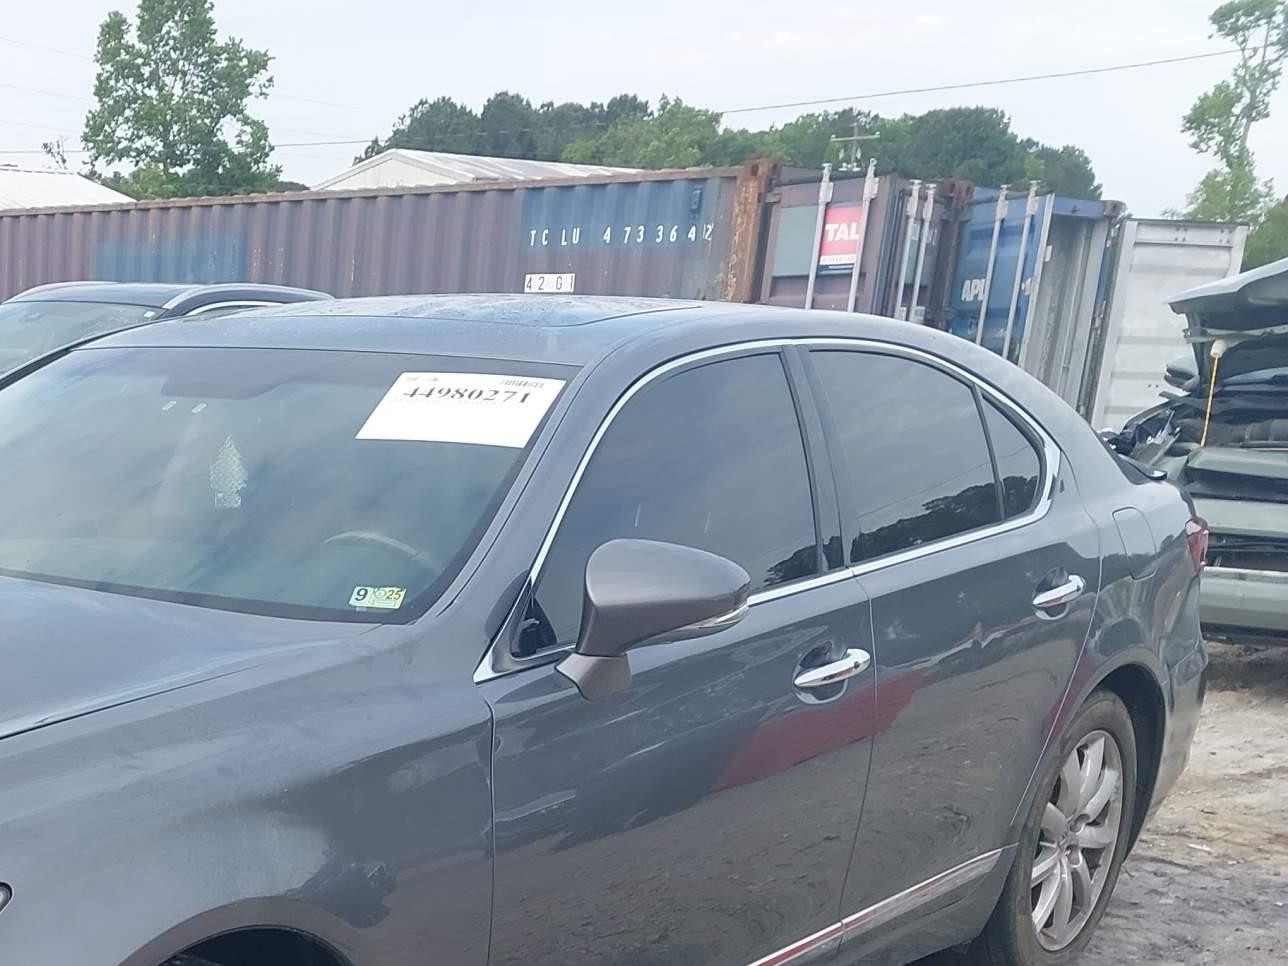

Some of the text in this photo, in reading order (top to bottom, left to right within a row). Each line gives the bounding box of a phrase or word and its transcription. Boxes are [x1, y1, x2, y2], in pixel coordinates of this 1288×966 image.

[825, 222, 861, 241] TAL
[403, 386, 532, 403] 44980271
[355, 588, 368, 601] 9
[385, 589, 402, 601] 25
